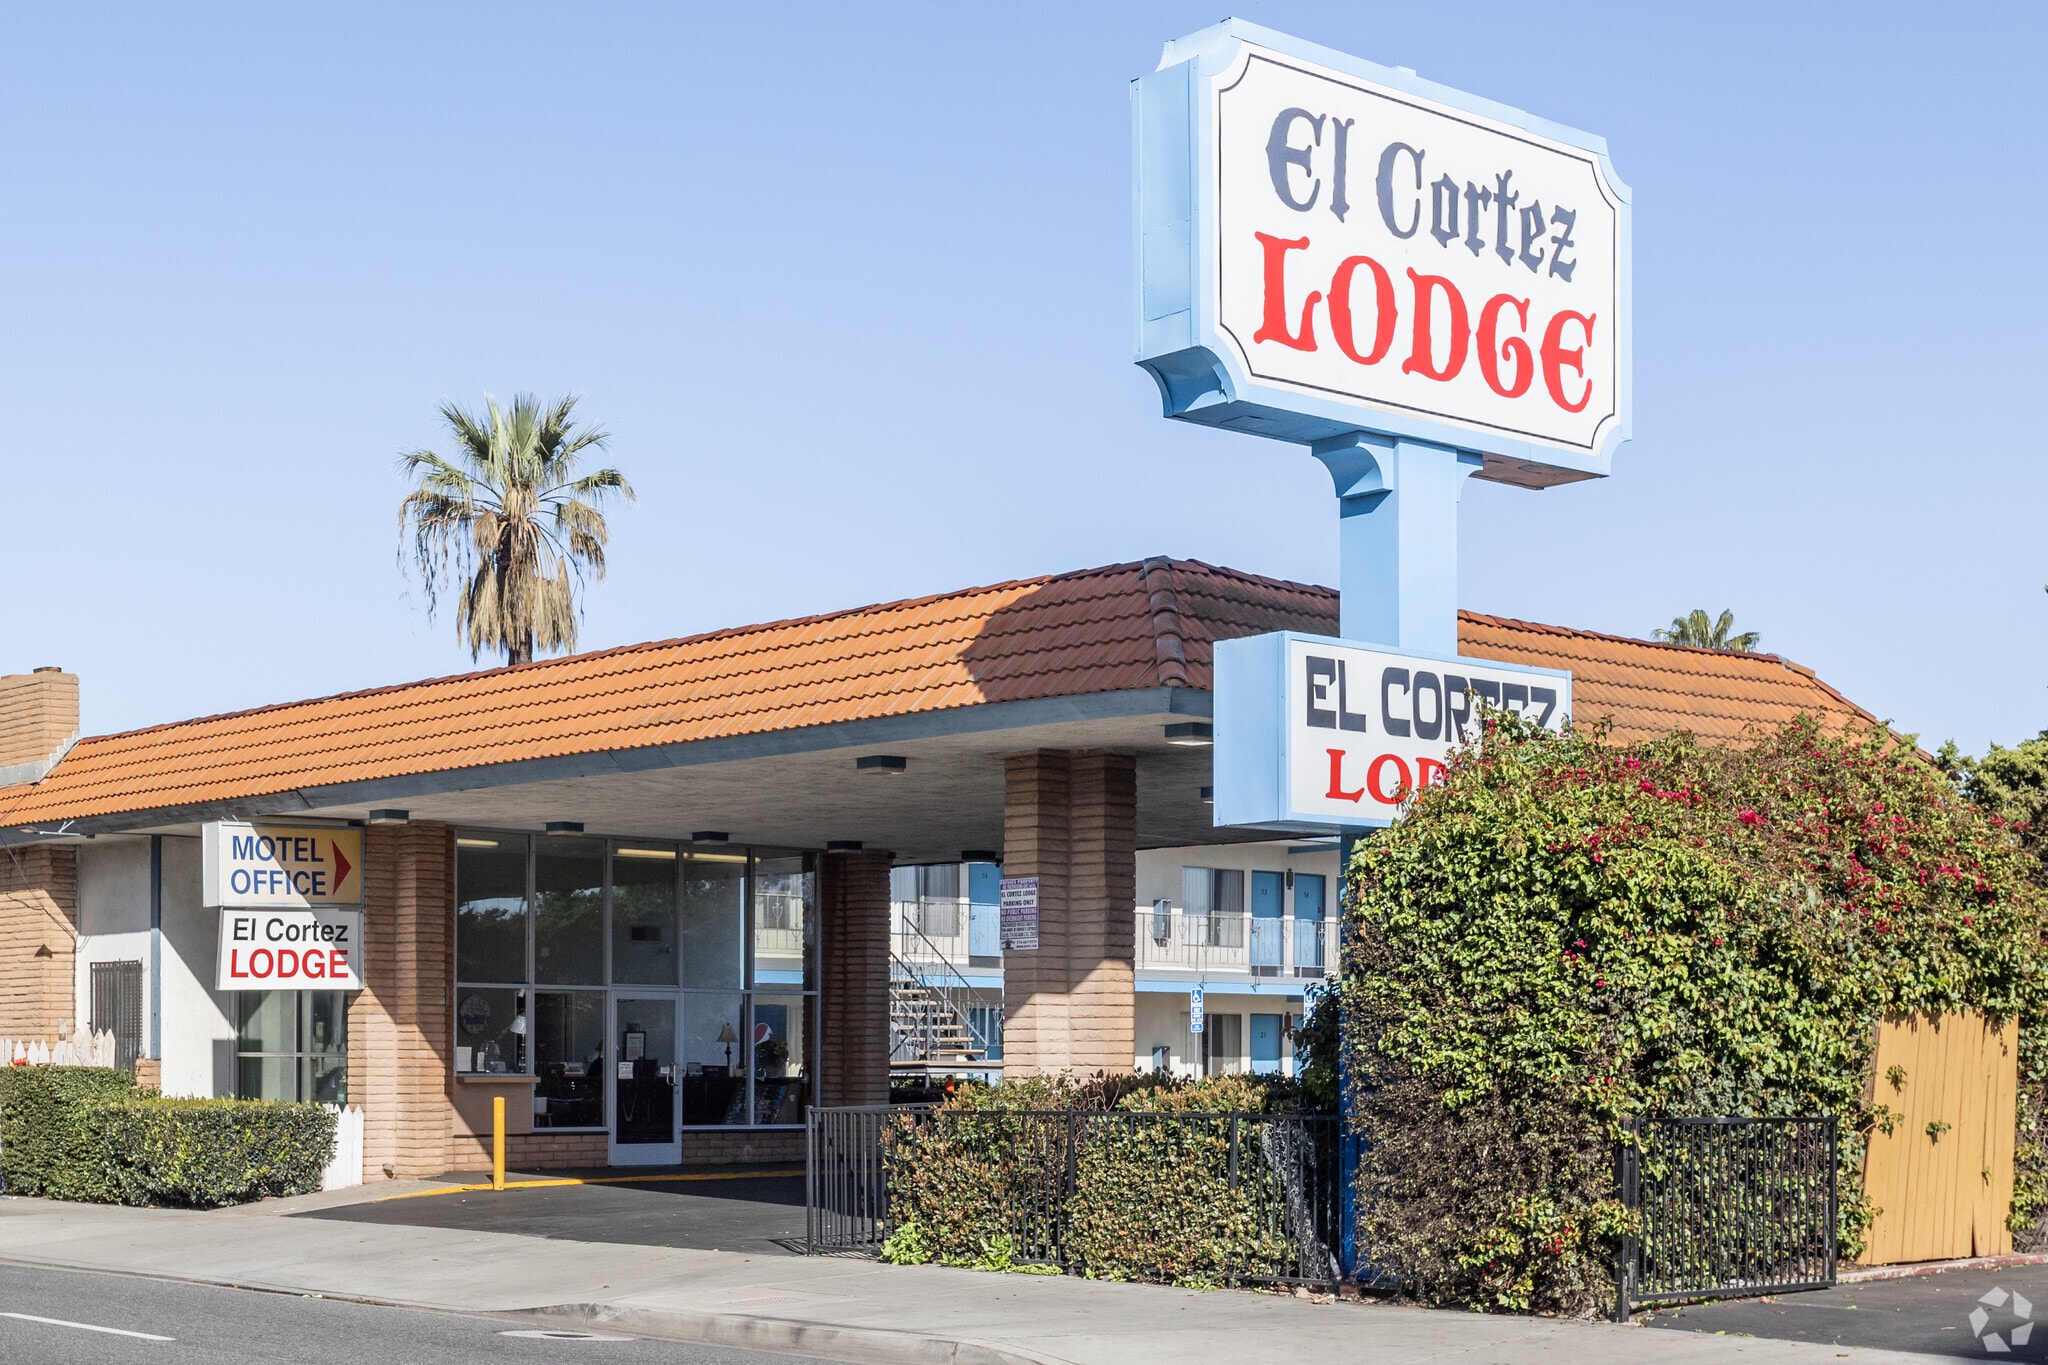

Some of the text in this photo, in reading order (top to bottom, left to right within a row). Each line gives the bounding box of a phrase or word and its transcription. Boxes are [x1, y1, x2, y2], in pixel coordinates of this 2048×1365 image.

[1266, 107, 1577, 283] El Cortez
[1252, 231, 1597, 413] LODGE
[1306, 655, 1366, 733] EL
[1325, 748, 1450, 804] LOD
[232, 835, 324, 862] MOTEL
[230, 869, 327, 896] OFFICE
[1007, 890, 1022, 898] CORTEZ
[1023, 889, 1036, 897] LODGE
[233, 918, 349, 942] El Cortez
[231, 948, 349, 979] LODGE
